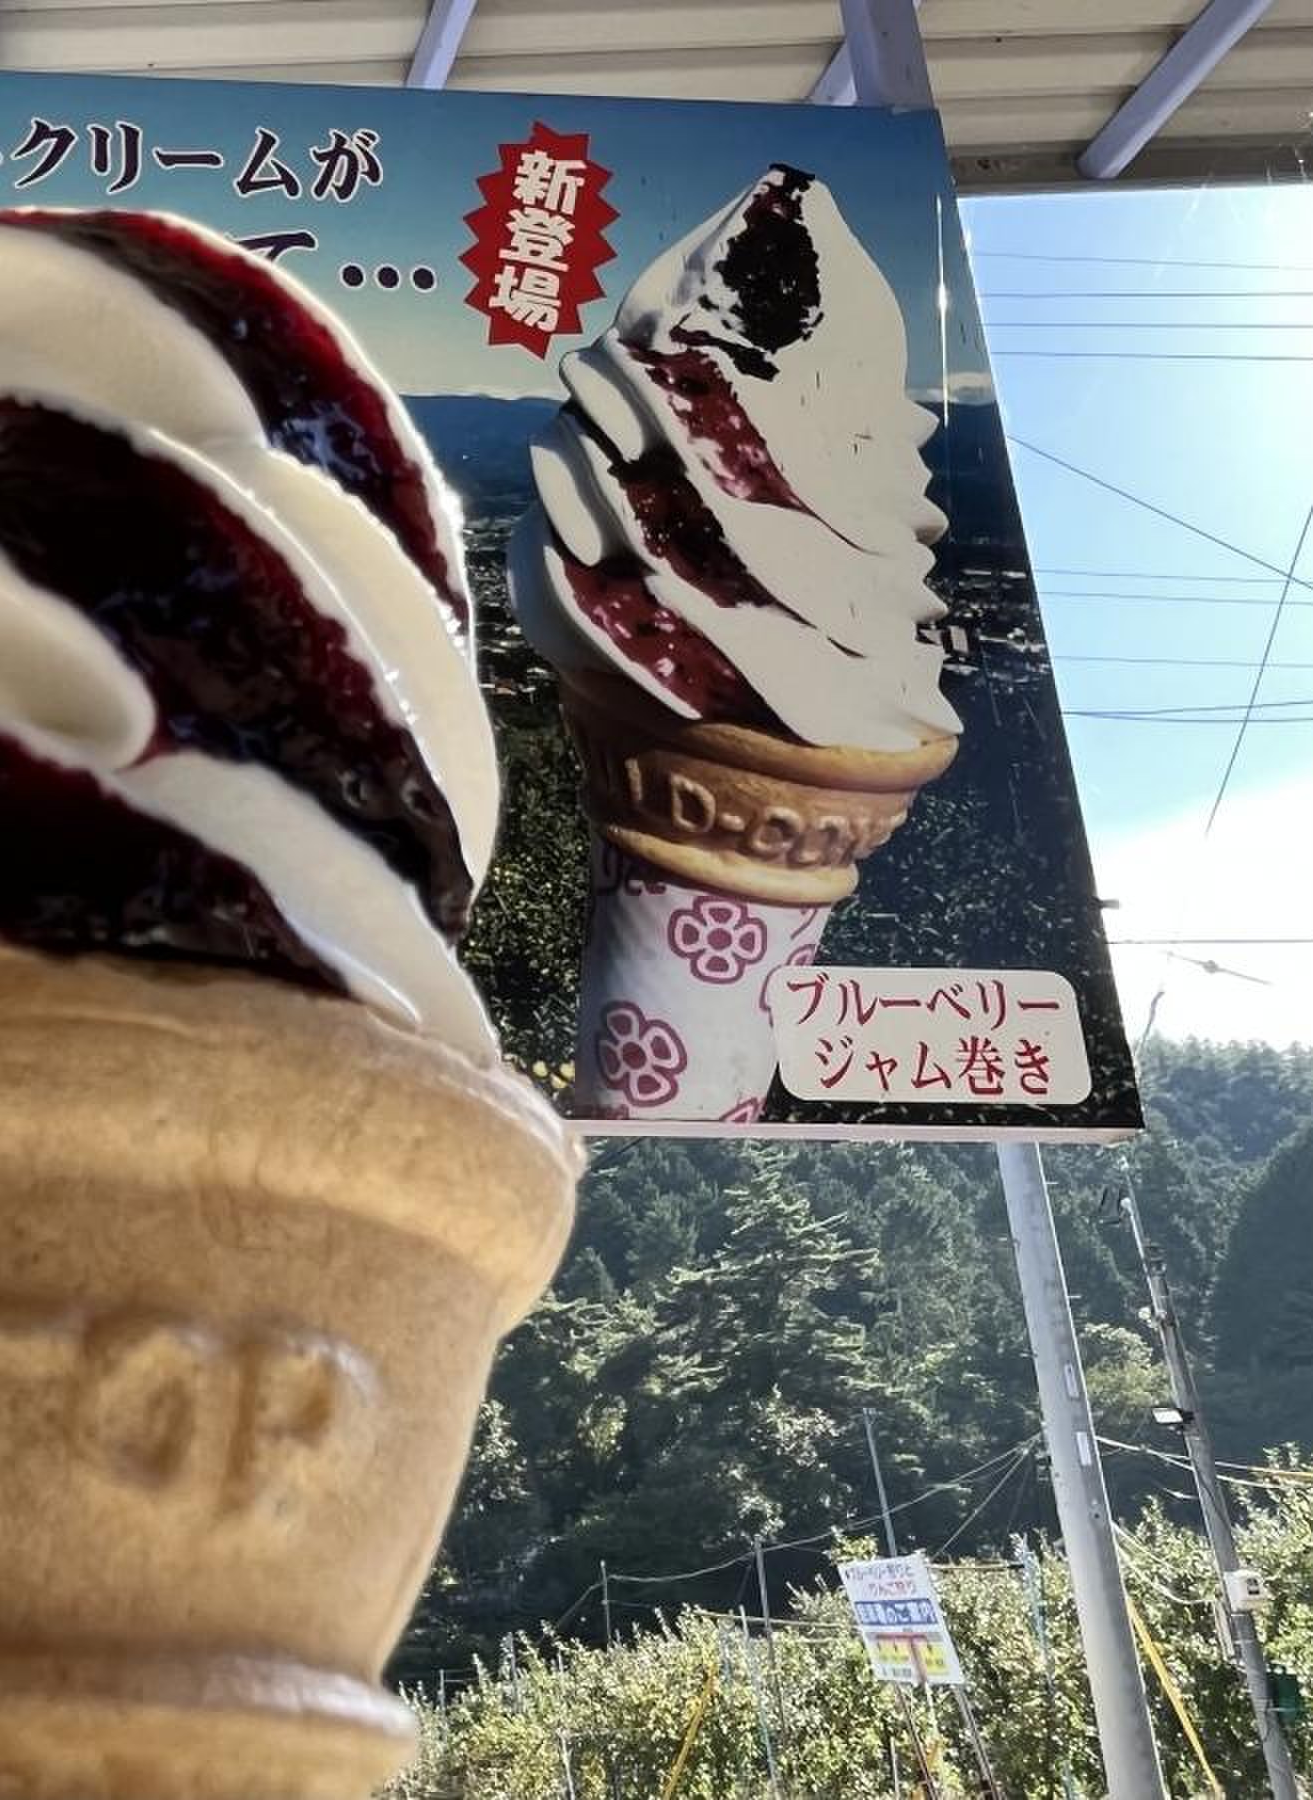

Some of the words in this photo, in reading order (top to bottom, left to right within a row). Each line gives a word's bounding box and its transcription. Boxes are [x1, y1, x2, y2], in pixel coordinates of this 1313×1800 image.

[489, 149, 586, 333] 新登場
[787, 972, 1060, 1030] ブルーベリー
[815, 1035, 1051, 1095] ジャム巻き
